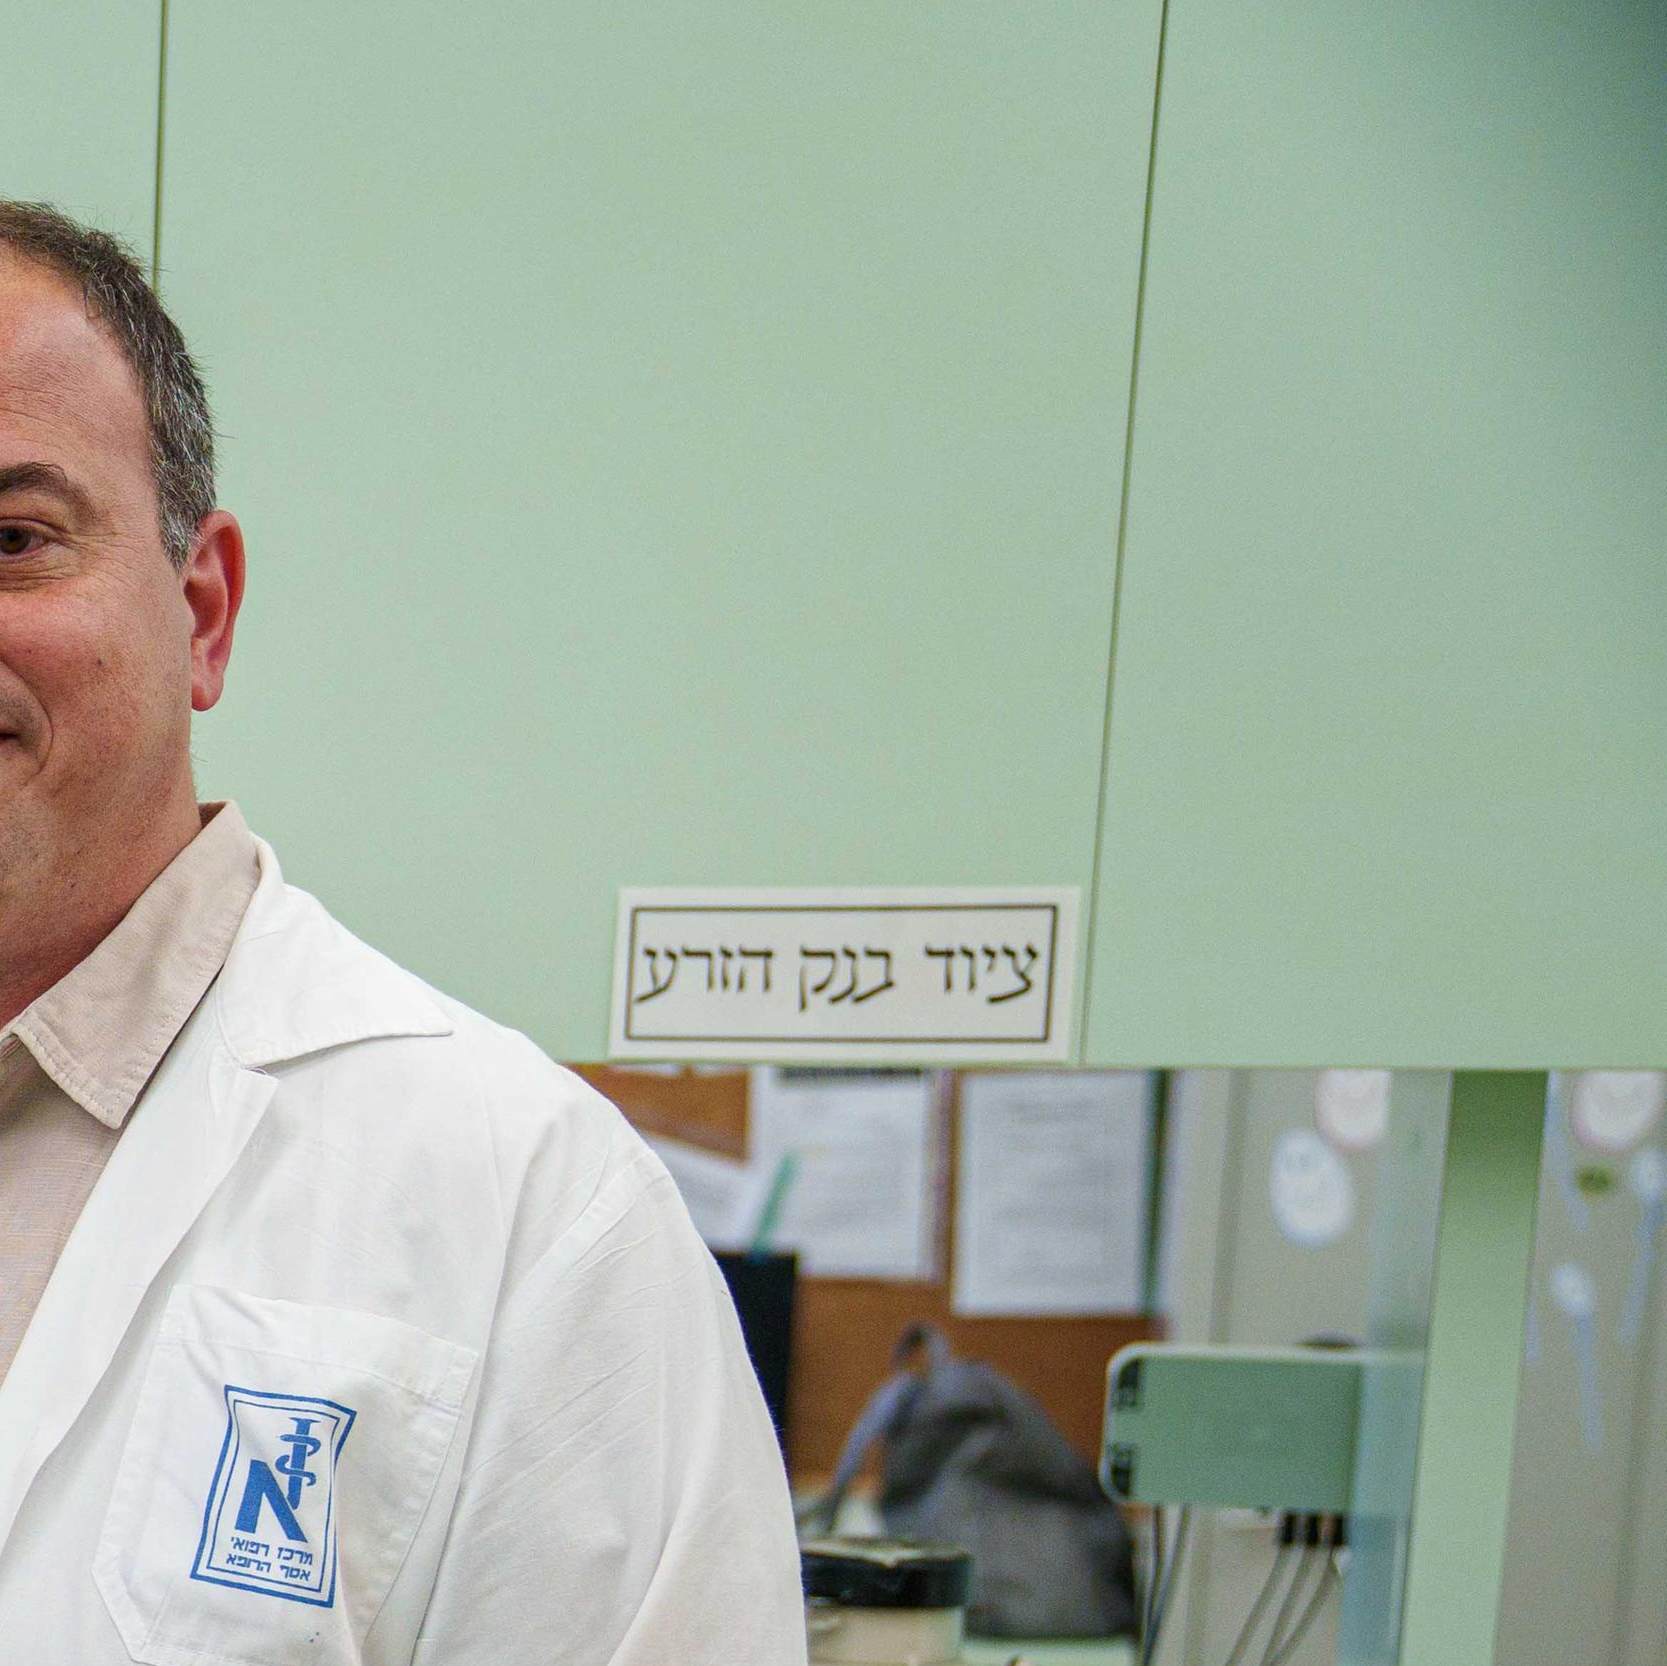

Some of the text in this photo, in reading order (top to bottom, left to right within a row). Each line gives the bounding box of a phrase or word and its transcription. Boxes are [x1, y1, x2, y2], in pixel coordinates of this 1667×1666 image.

[799, 945, 894, 1012] בנק
[925, 942, 1039, 1004] ציוד
[225, 1553, 312, 1582] אסף הרופא
[230, 1536, 313, 1566] מרכז רפואי
